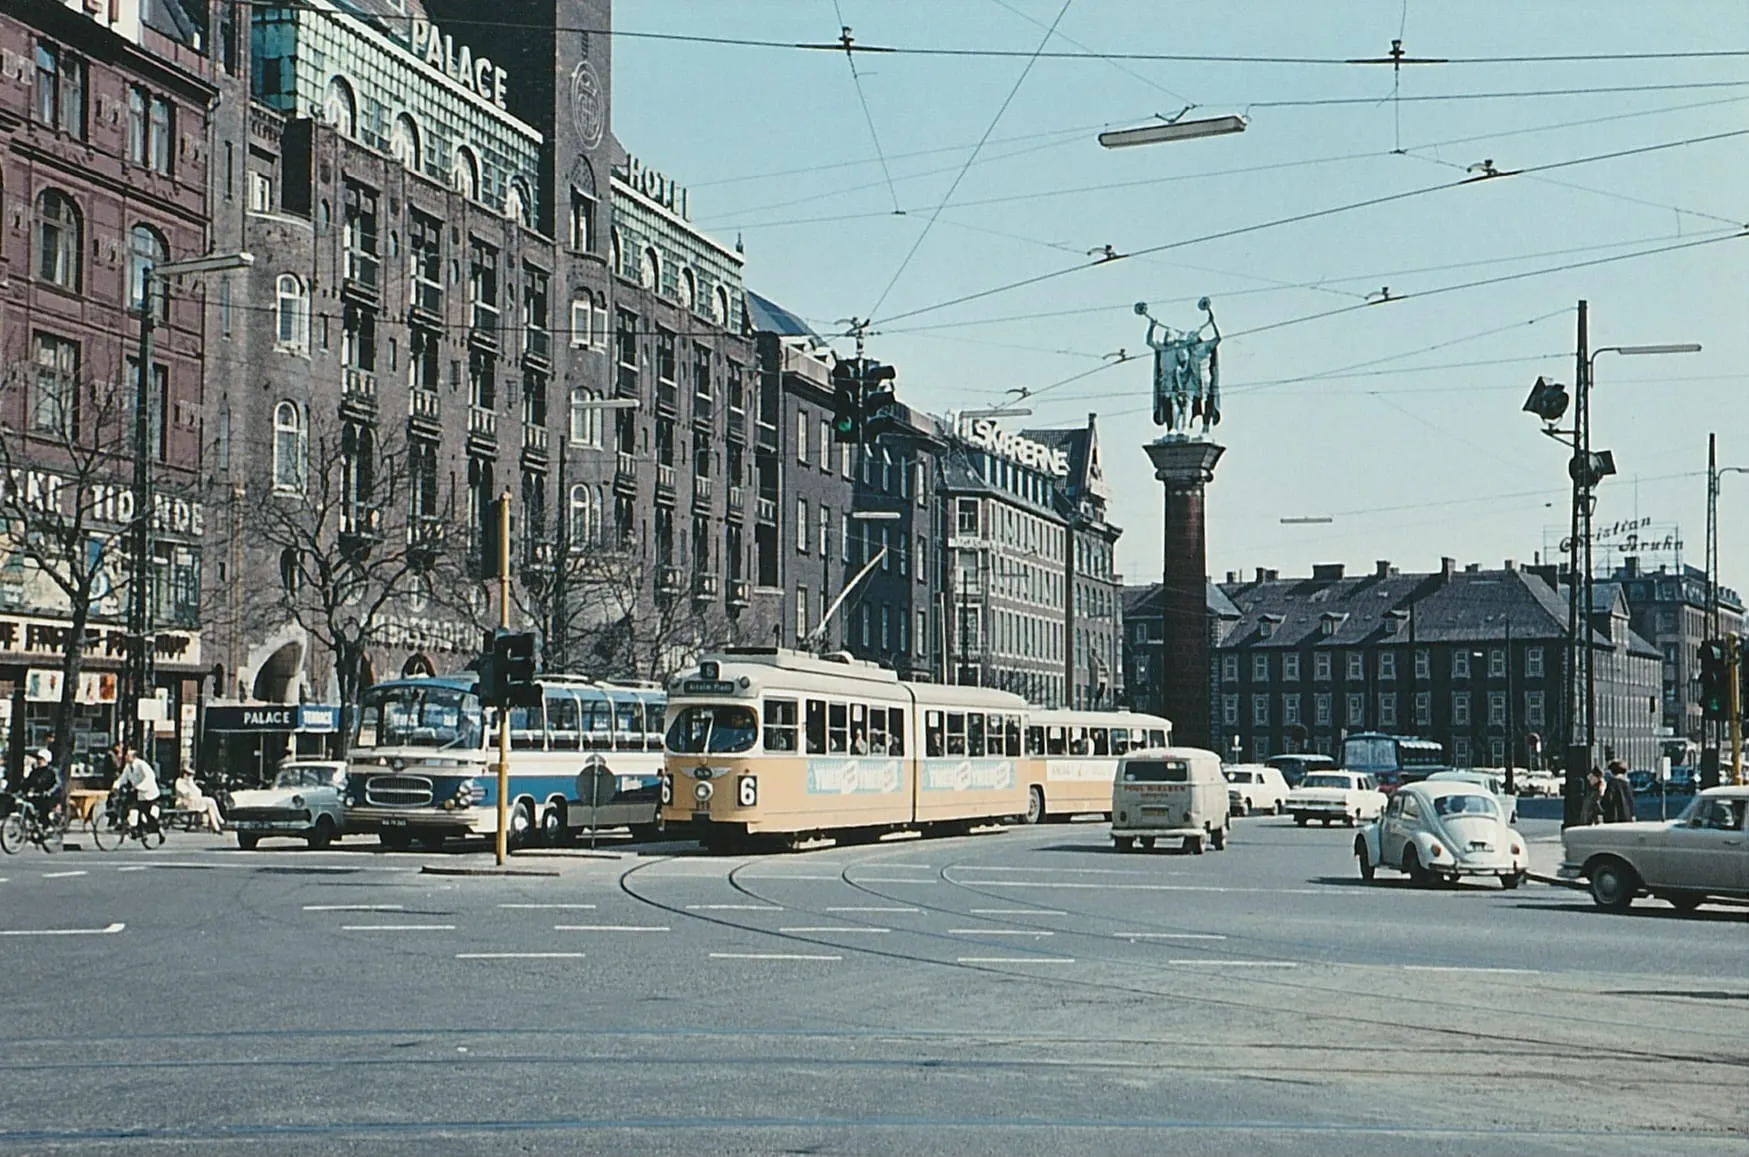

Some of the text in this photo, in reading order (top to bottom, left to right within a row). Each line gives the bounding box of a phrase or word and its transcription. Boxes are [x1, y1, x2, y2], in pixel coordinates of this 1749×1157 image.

[412, 16, 508, 111] PALACE
[627, 153, 692, 223] HOTEL
[91, 484, 204, 536] TIDNDE
[705, 664, 715, 678] 6
[243, 711, 290, 725] PALACE
[661, 776, 671, 804] 6
[740, 777, 755, 806] 6
